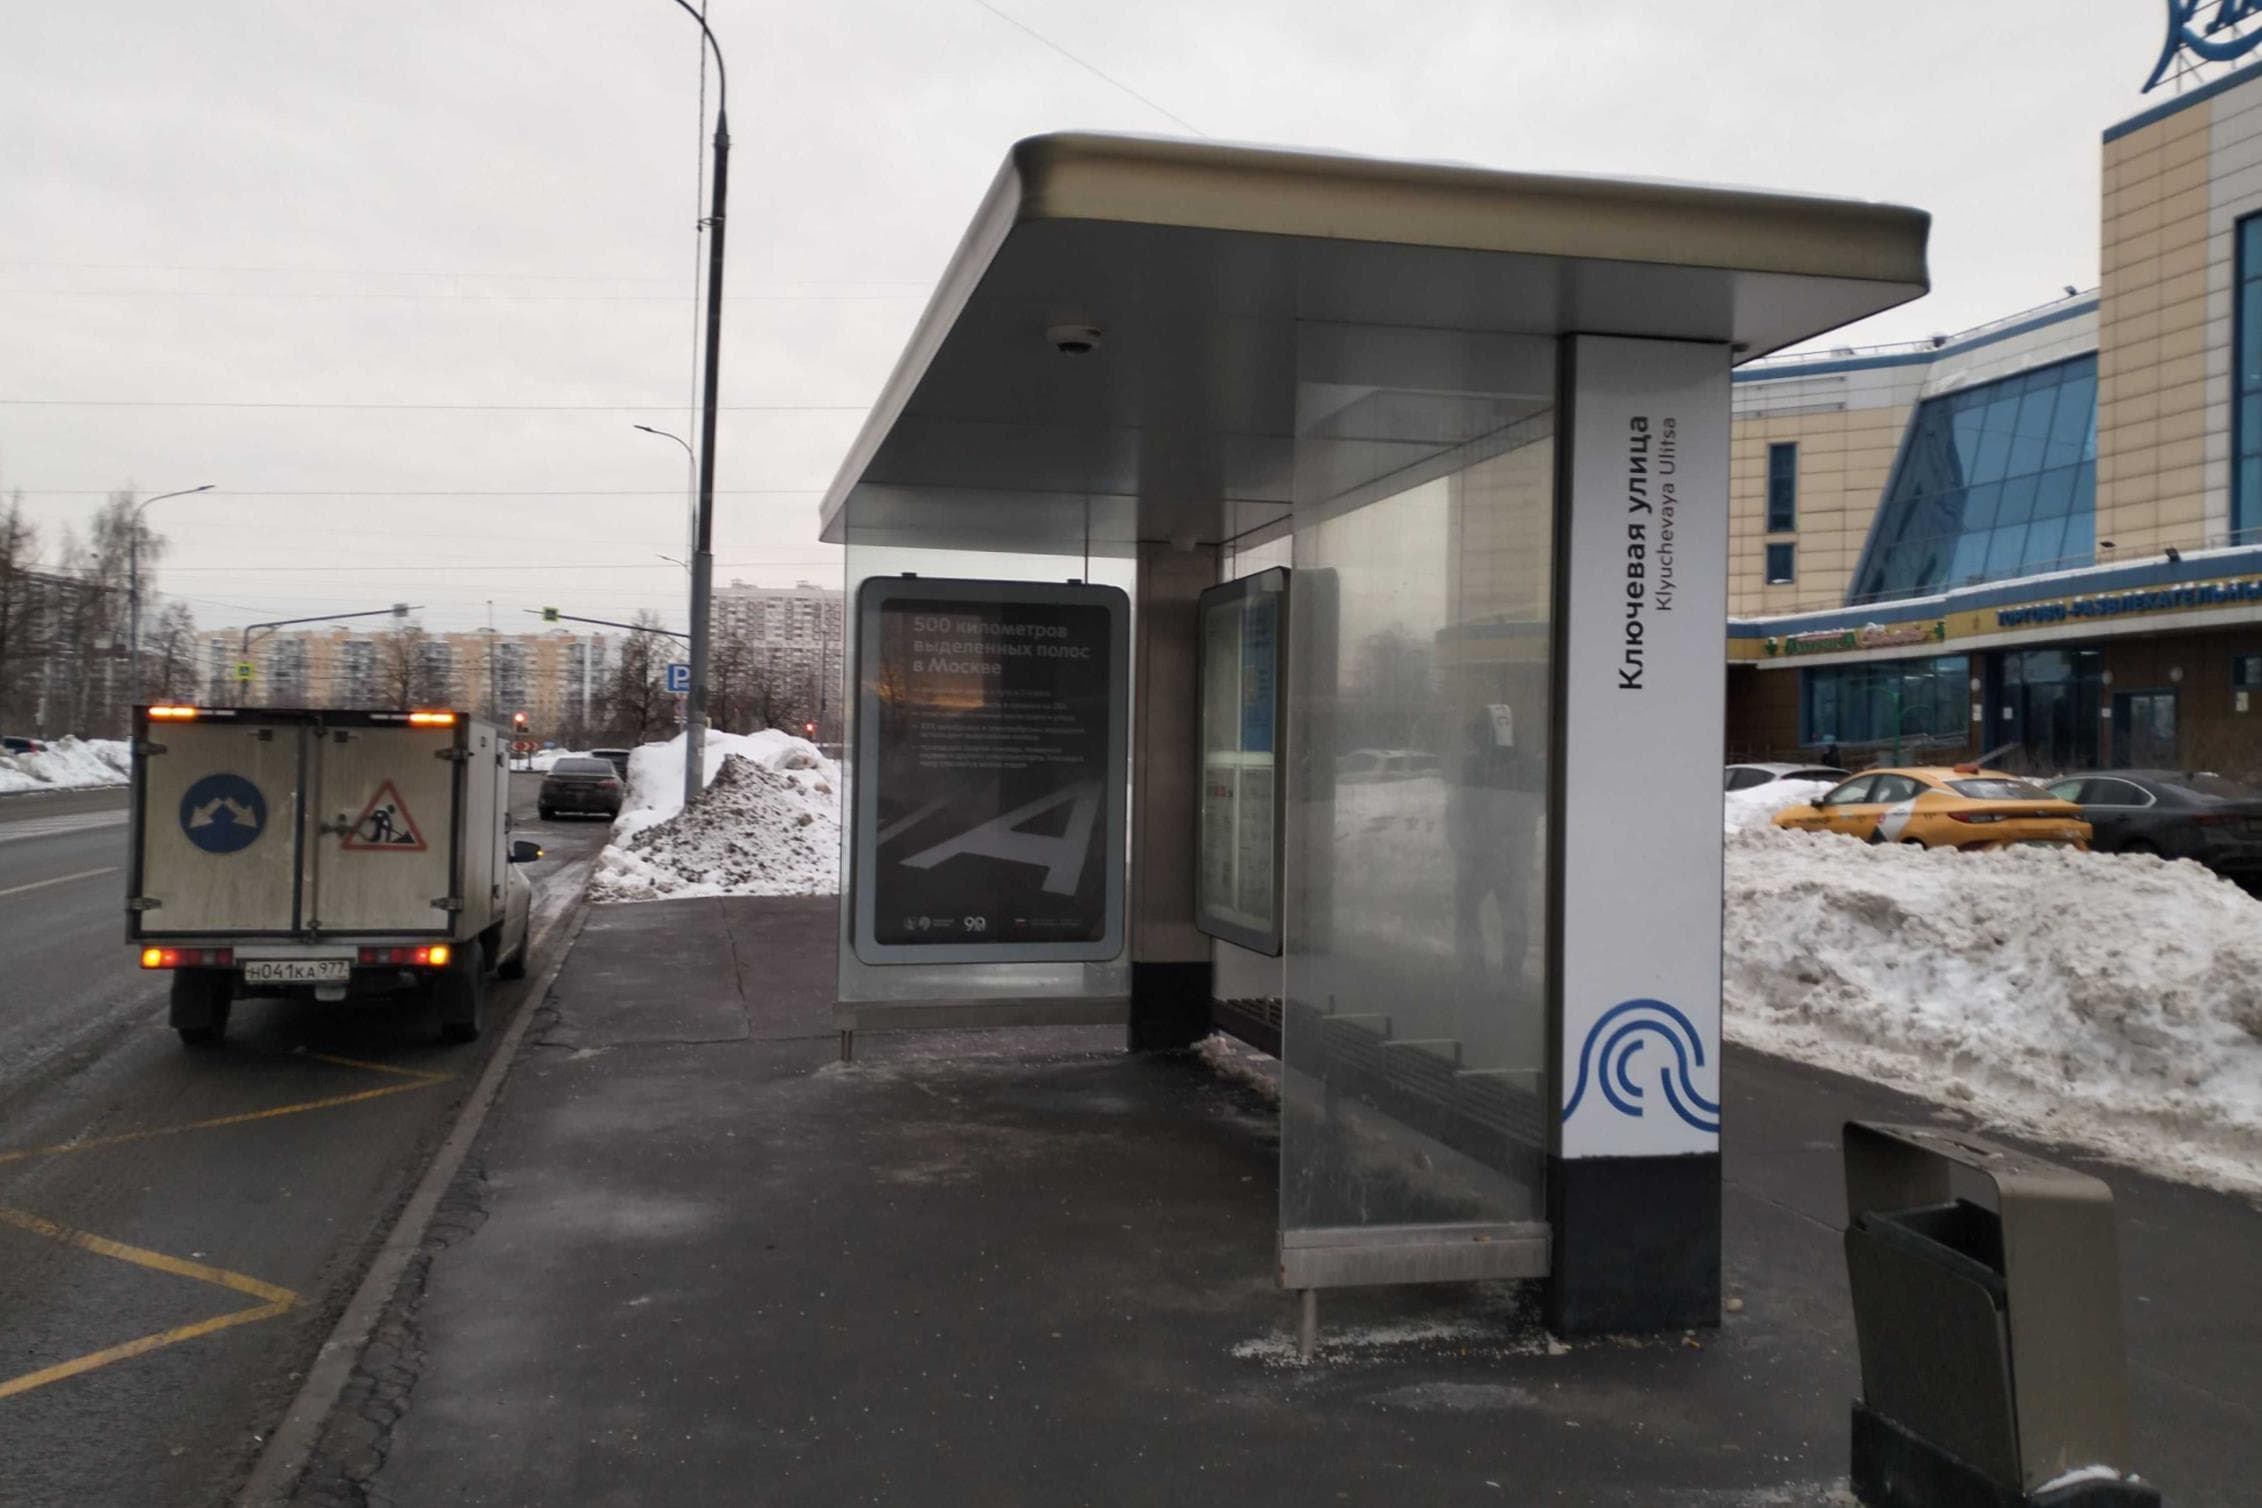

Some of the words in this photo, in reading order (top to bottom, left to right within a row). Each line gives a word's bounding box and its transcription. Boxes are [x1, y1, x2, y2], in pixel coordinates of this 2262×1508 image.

[1628, 416, 1652, 514] улица
[1658, 417, 1677, 475] Ulitsa
[1656, 483, 1678, 612] Klyuchevaya
[913, 616, 951, 633] 500
[955, 622, 1068, 640] километров
[1618, 523, 1646, 690] Ключевая
[912, 640, 1032, 658] выделенных
[1036, 645, 1091, 659] полос
[912, 660, 924, 673] в
[927, 657, 1003, 675] Москве
